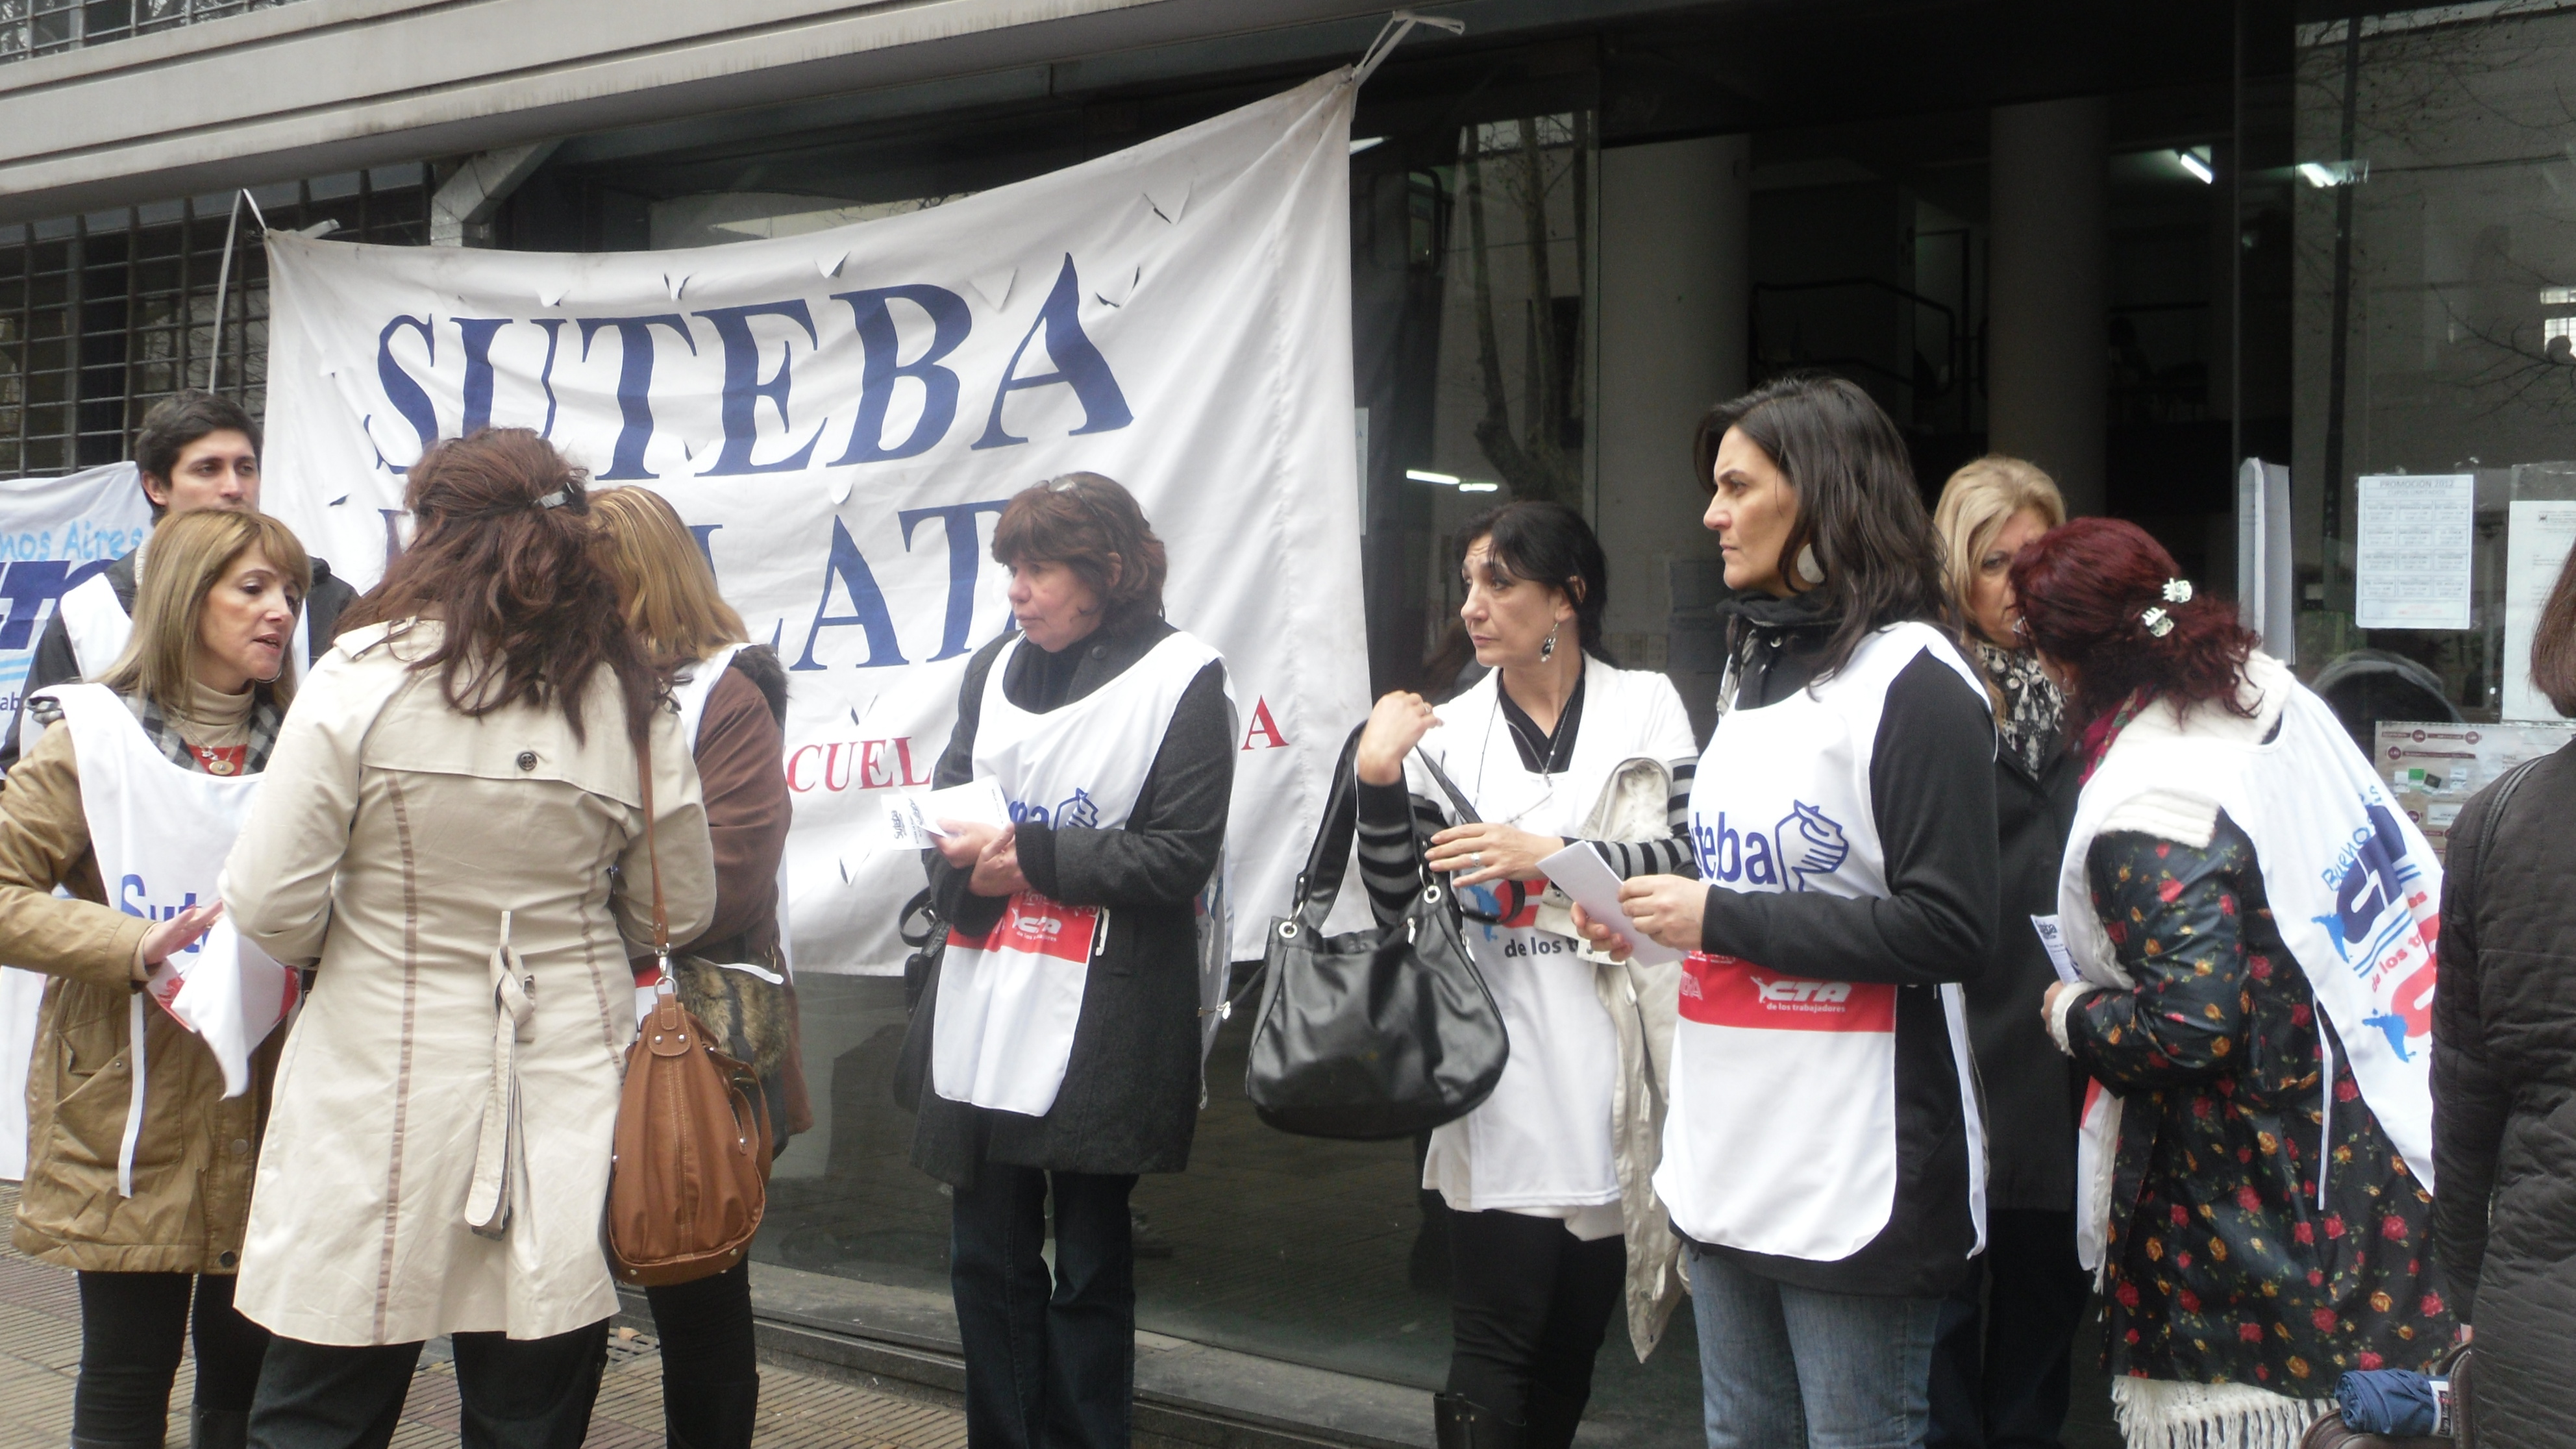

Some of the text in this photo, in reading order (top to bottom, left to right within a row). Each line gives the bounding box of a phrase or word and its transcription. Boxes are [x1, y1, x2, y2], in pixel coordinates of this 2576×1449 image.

[364, 252, 1134, 481] SUTEBA
[0, 530, 51, 560] nos
[783, 737, 933, 793] CUEL
[1504, 939, 1527, 958] de
[1530, 937, 1563, 955] los
[1766, 981, 1852, 1002] CTA
[1766, 1002, 1846, 1013] de los trabajadores
